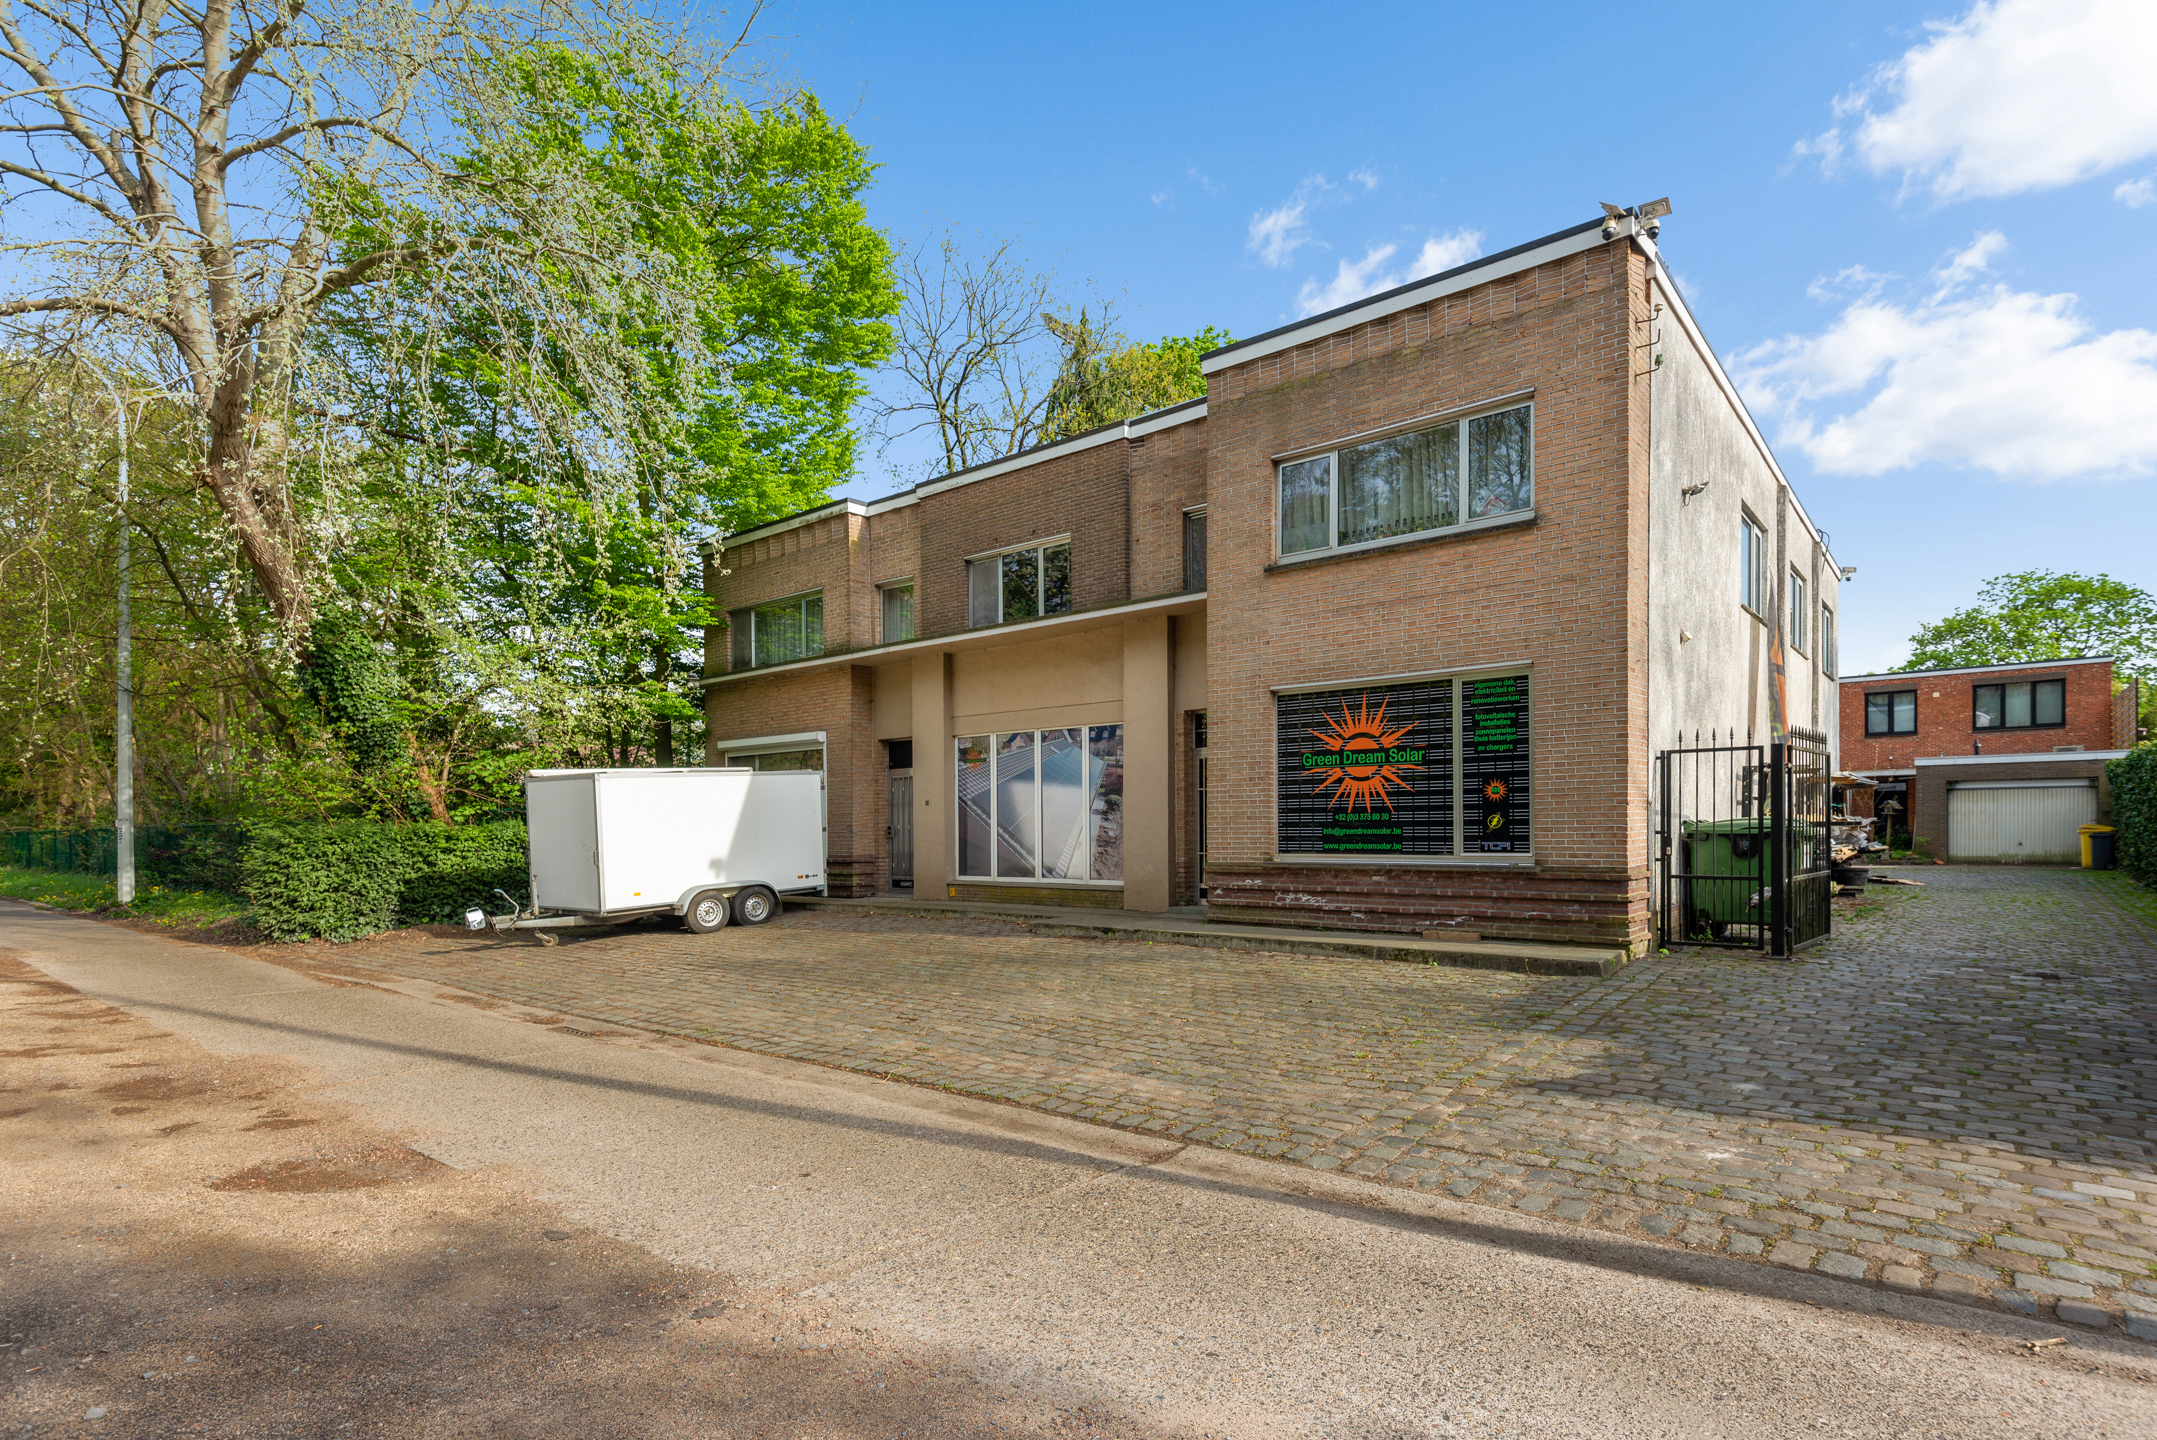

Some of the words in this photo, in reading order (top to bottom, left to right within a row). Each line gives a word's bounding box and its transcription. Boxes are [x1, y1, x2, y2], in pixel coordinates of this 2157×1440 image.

[1475, 686, 1507, 694] elektriciteit
[1471, 695, 1519, 704] renovatiewerken
[1475, 727, 1516, 735] zonnepanelen
[1303, 752, 1340, 766] Green
[1343, 750, 1386, 764] Dream
[1389, 747, 1425, 762] Solar
[1323, 827, 1402, 836] info@greendreamsolar.be
[1323, 842, 1402, 851] www.greendreamsolar.be
